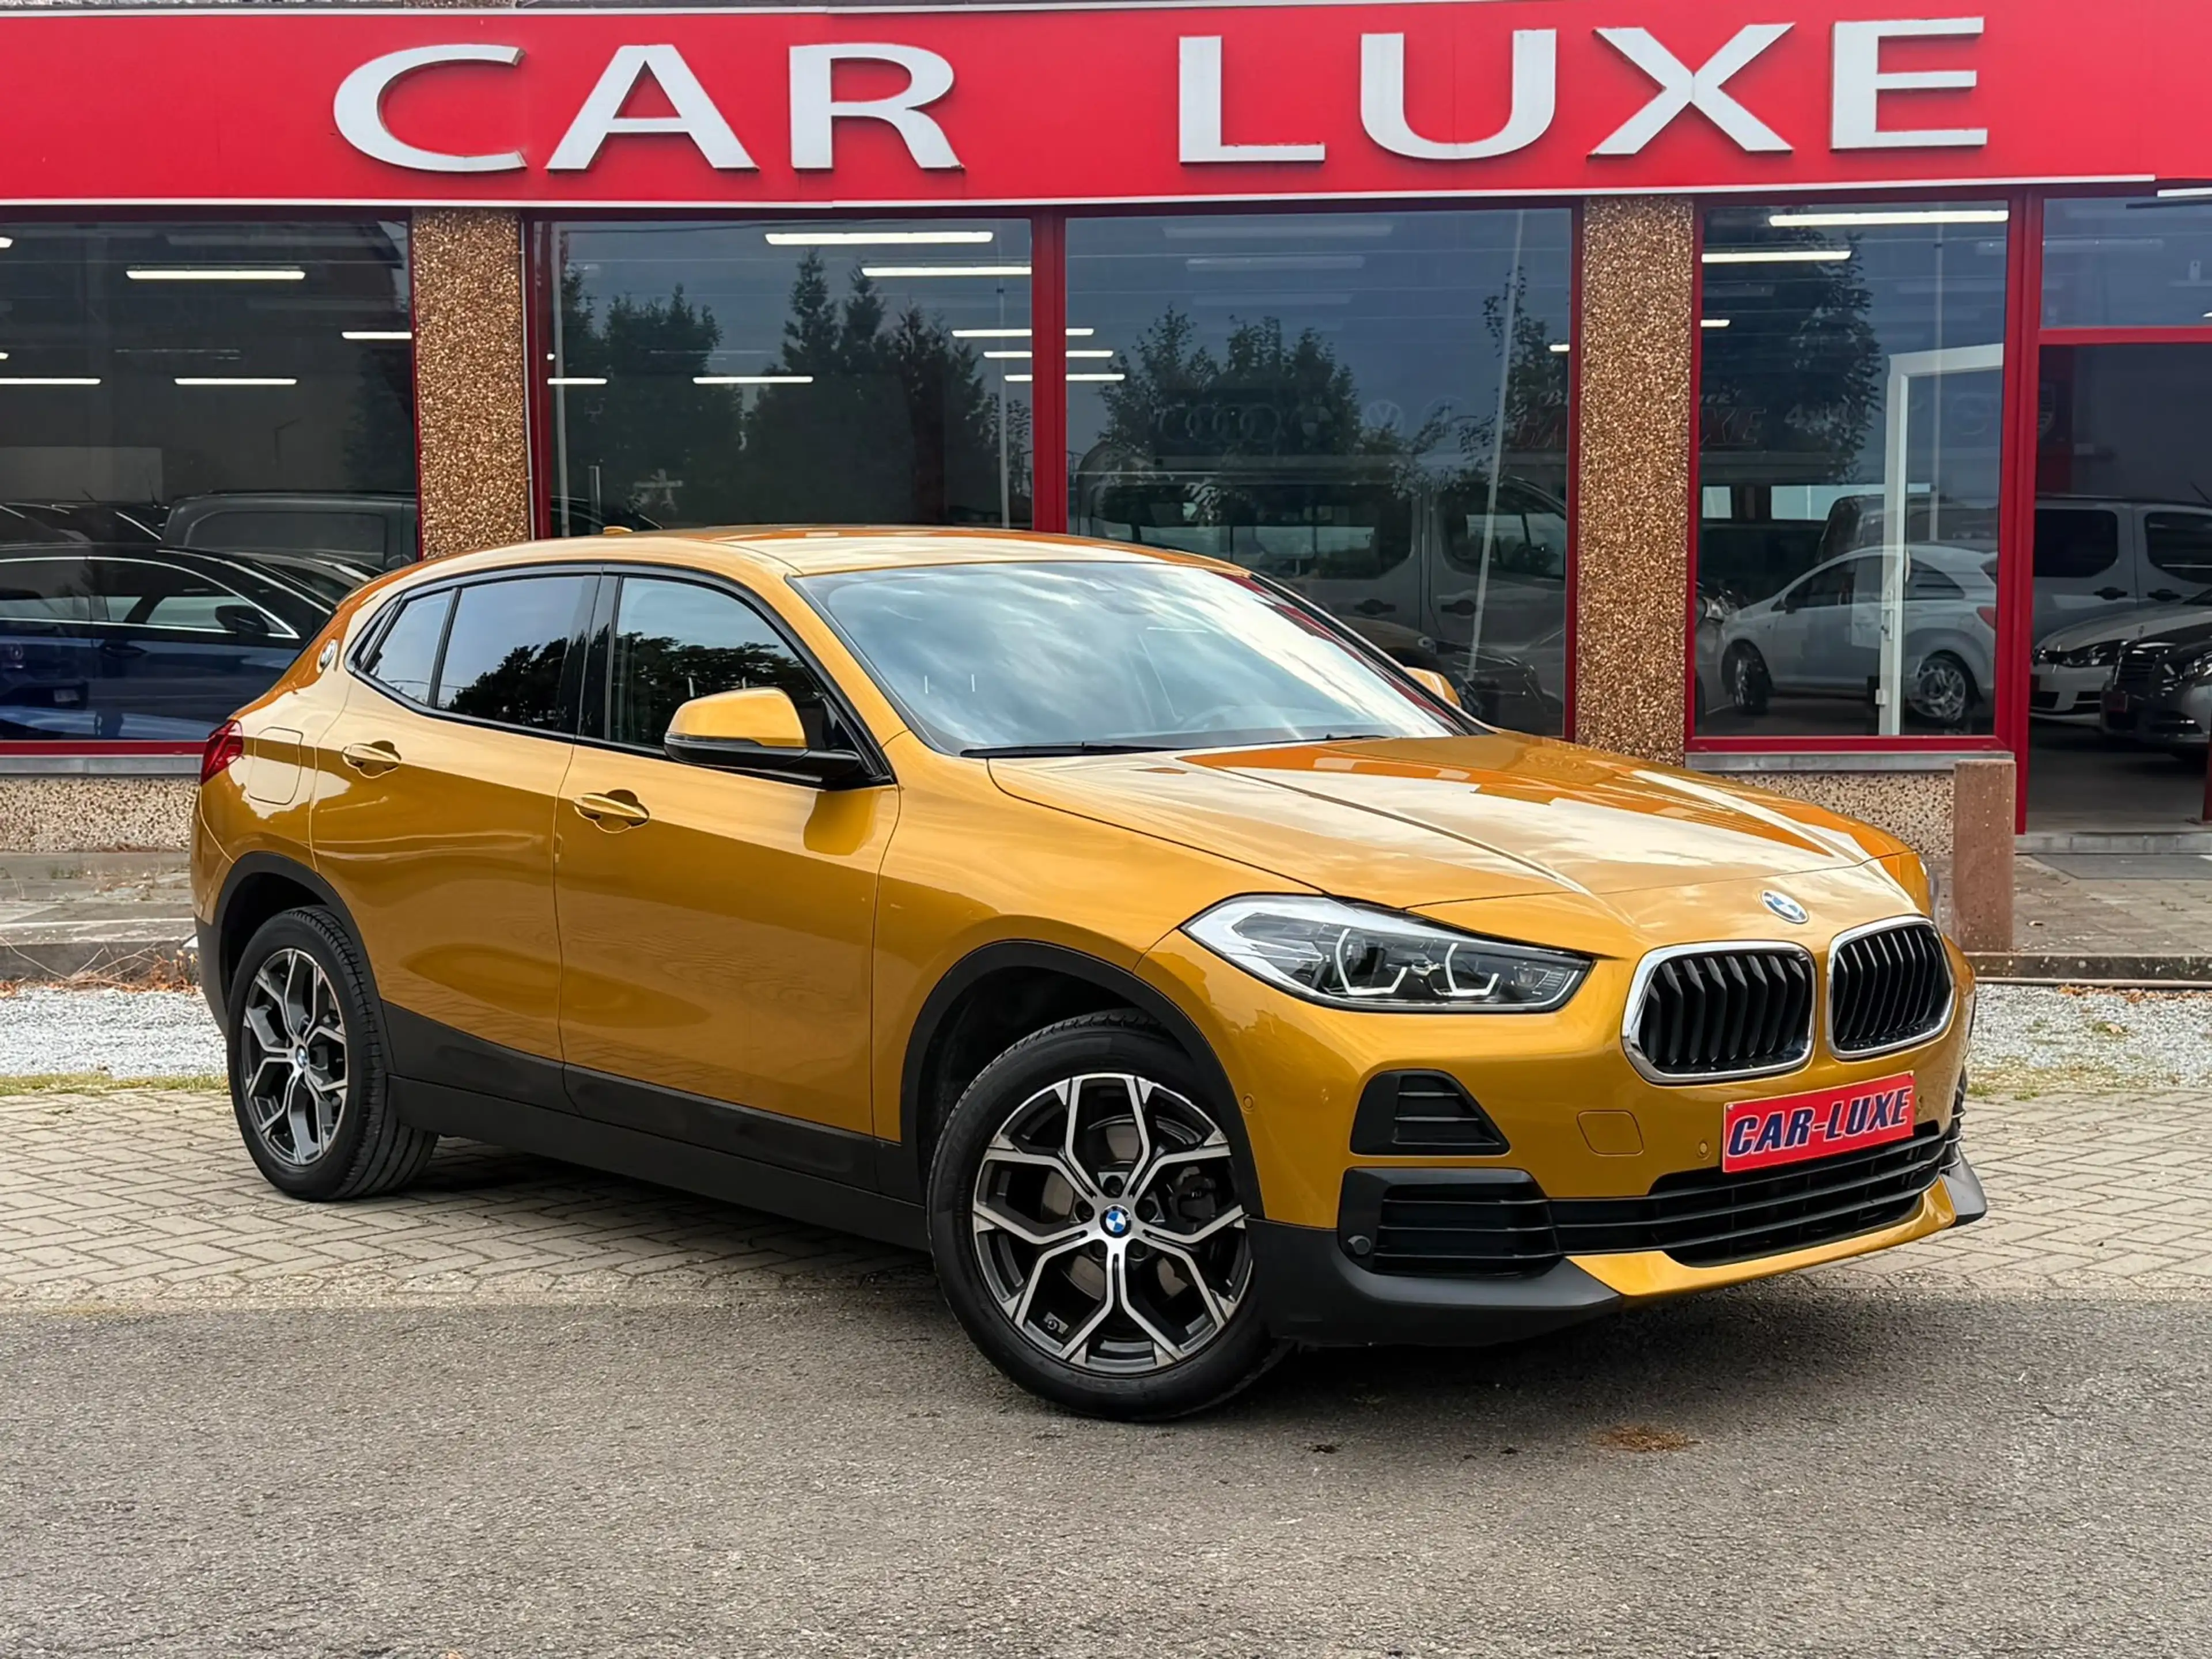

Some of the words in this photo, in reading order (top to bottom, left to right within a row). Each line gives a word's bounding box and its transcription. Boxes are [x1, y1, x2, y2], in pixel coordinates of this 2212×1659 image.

[334, 43, 965, 173] CAR
[1179, 16, 1988, 164] LUXE
[1727, 1085, 1914, 1158] CAR-LUXE
